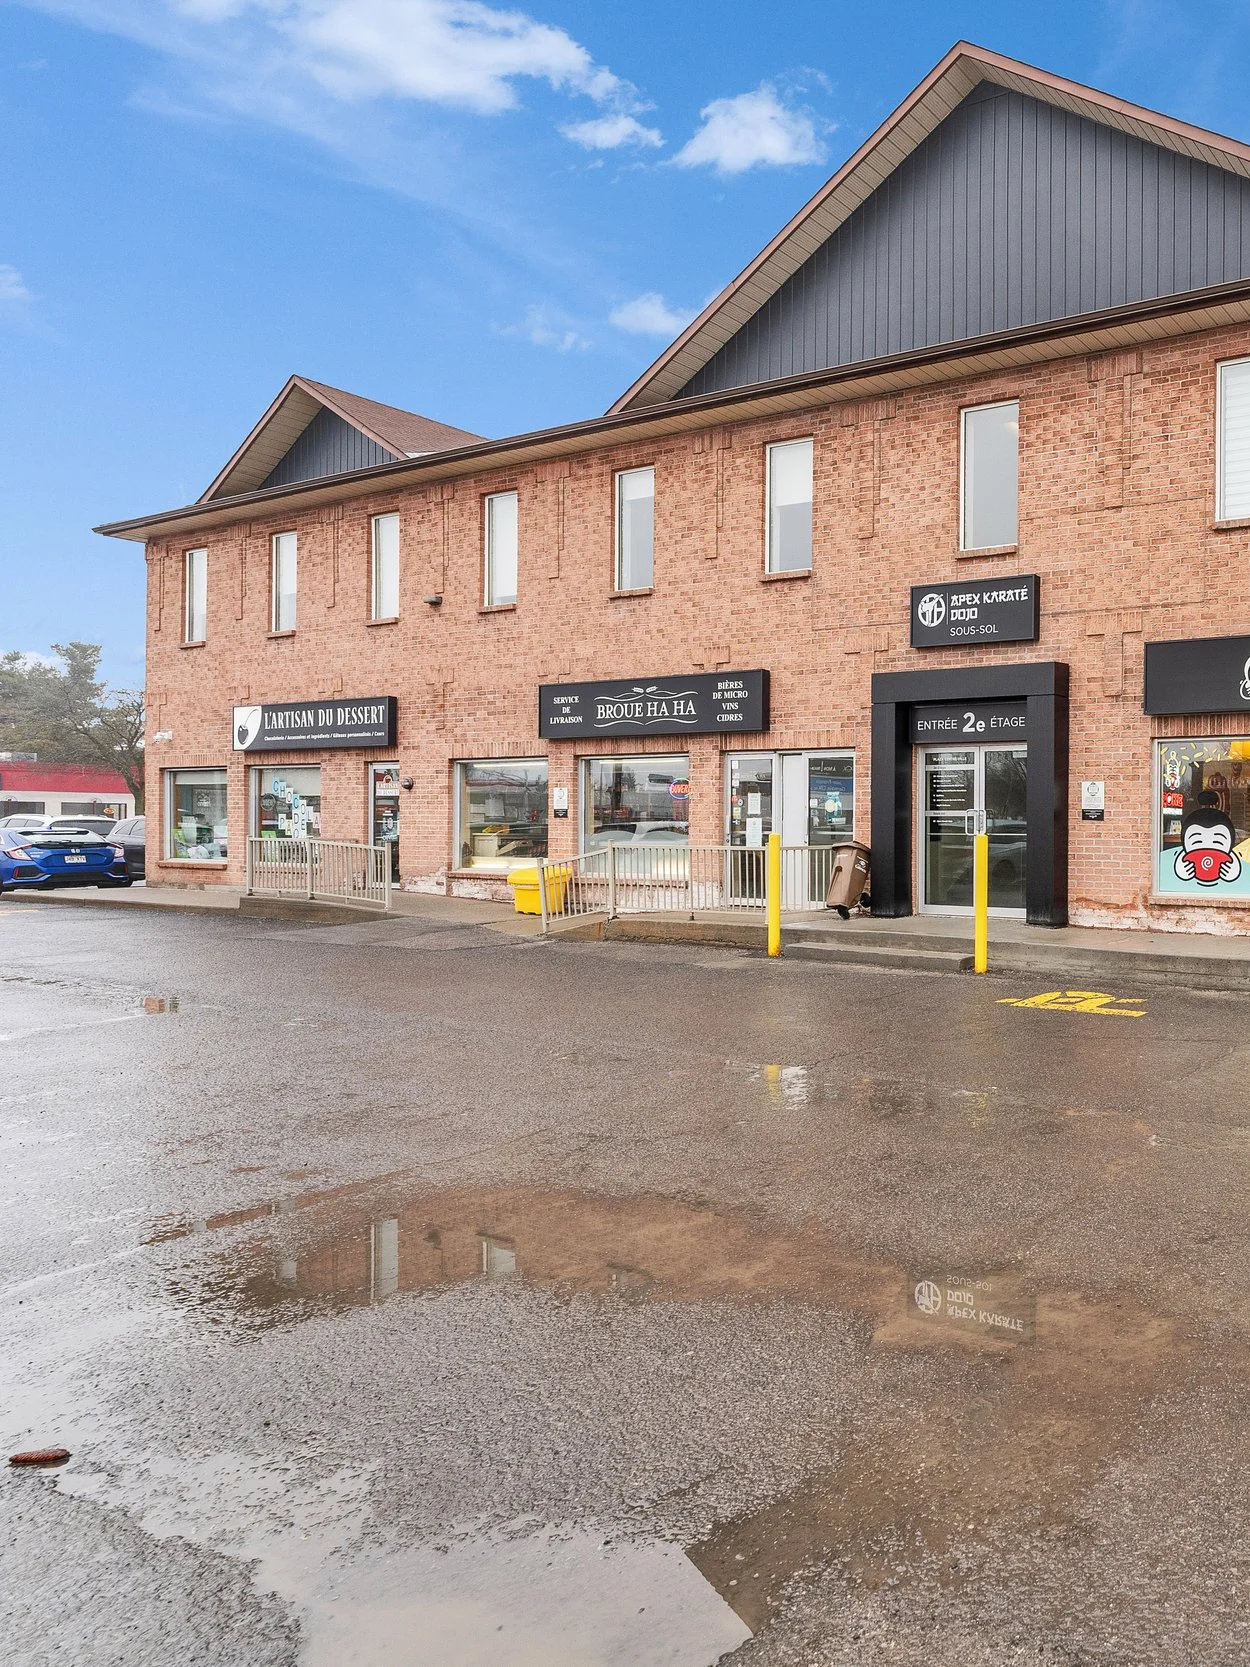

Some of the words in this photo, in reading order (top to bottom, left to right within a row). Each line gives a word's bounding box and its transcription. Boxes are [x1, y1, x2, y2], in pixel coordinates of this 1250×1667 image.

[950, 593, 980, 607] APEX
[983, 585, 1028, 604] KARATÉ
[951, 608, 978, 621] DOJO
[950, 624, 998, 637] SOUS-SOL
[717, 680, 743, 690] BIÈRES
[553, 696, 579, 704] SERVICE
[712, 692, 723, 700] DE
[724, 690, 749, 699] MICRO
[562, 706, 571, 714] DE
[596, 702, 643, 719] BROUE
[646, 701, 670, 716] HA
[672, 700, 697, 715] HA
[722, 702, 739, 710] VINS
[264, 709, 314, 730] L'ARTISAN
[318, 708, 333, 727] DU
[337, 705, 385, 725] DESSERT
[549, 716, 583, 725] LIVRAISON
[716, 713, 743, 722] CIDRES
[917, 717, 957, 731] ENTRÉE
[962, 712, 986, 733] 2e
[990, 715, 1026, 728] ÉTAGE
